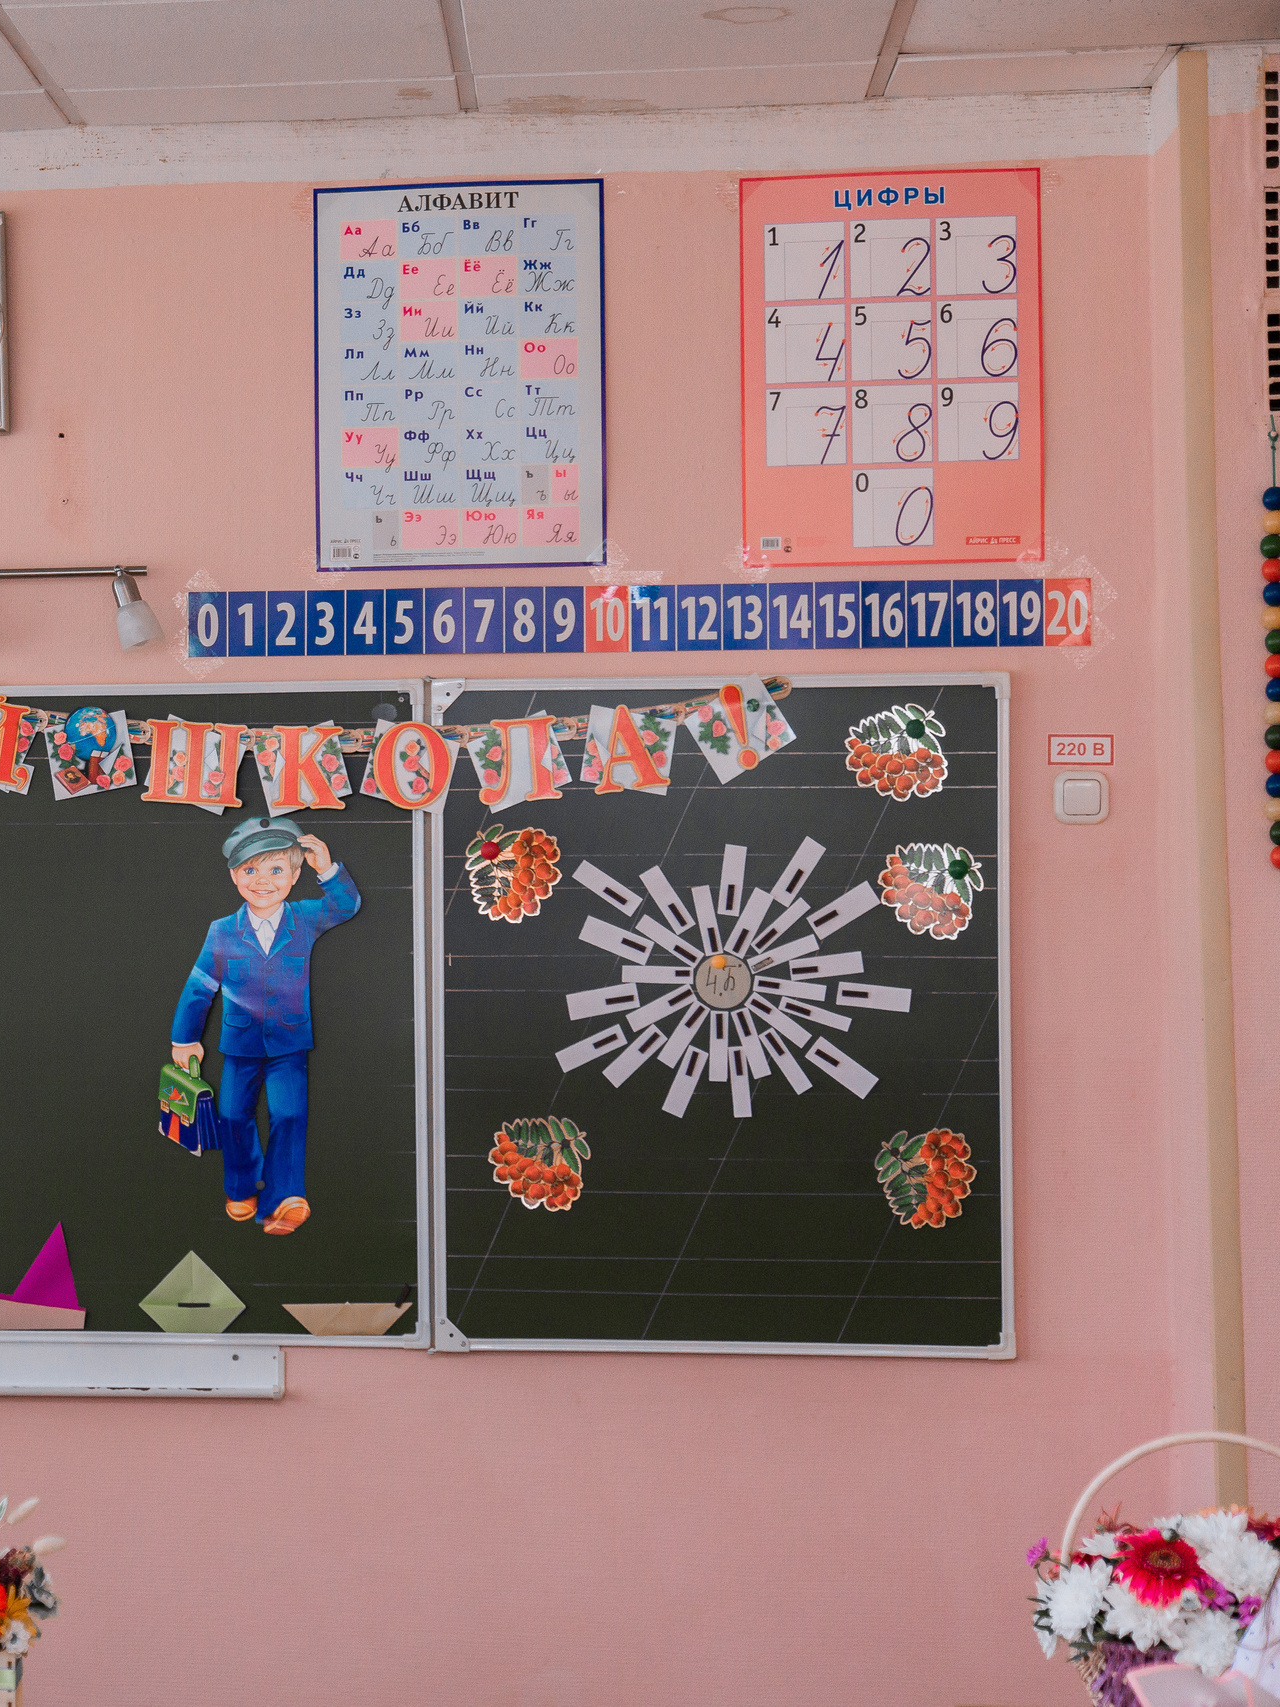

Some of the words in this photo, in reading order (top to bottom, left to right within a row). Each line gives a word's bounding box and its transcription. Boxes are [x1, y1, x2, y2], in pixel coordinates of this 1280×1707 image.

[398, 192, 518, 212] АЛФАВИТ
[835, 187, 944, 210] ЦИФРЫ
[344, 226, 361, 235] Аа
[403, 221, 420, 232] Бб
[464, 220, 479, 230] Вв
[524, 218, 536, 228] Гг
[768, 227, 778, 246] 1
[854, 224, 865, 243] 2
[940, 221, 951, 240] 3
[344, 267, 365, 279] Дд
[403, 265, 418, 274] Ее
[465, 261, 480, 272] Ёё
[524, 260, 551, 270] Жж
[345, 308, 361, 318] Зз
[403, 306, 421, 316] Ии
[465, 303, 483, 314] Йй
[525, 302, 542, 312] Кк
[768, 309, 781, 328] 4
[855, 306, 866, 325] 5
[941, 304, 952, 323] 6
[345, 349, 363, 359] Лл
[405, 348, 429, 357] Мм
[465, 345, 483, 355] Нн
[524, 342, 545, 353] Оо
[345, 391, 363, 401] Пп
[405, 389, 423, 401] Рр
[465, 387, 482, 397] Сс
[526, 385, 540, 395] Тт
[770, 392, 781, 411] 7
[855, 389, 868, 409] 8
[942, 387, 953, 407] 9
[345, 432, 362, 444] Уу
[404, 430, 429, 442] Фф
[466, 429, 482, 439] Хх
[527, 427, 547, 439] Цц
[346, 472, 362, 482] Чч
[404, 471, 431, 481] Шш
[467, 469, 495, 481] Щщ
[856, 473, 869, 492] 0
[405, 512, 421, 522] Ээ
[466, 511, 496, 521] Юю
[527, 509, 544, 519] Яя
[197, 603, 218, 647] 0
[238, 604, 254, 646] 1
[275, 603, 296, 646] 2
[315, 602, 335, 646] 3
[353, 602, 376, 645] 4
[394, 601, 414, 644] 5
[432, 599, 456, 643] 6
[474, 599, 494, 643] 7
[512, 599, 536, 643] 8
[555, 597, 576, 642] 9
[590, 598, 625, 642] 10
[636, 597, 669, 641] 11
[681, 596, 718, 640] 12
[727, 595, 763, 640] 13
[772, 594, 811, 639] 14
[819, 594, 856, 639] 15
[865, 593, 904, 637] 16
[911, 592, 948, 637] 17
[957, 592, 996, 636] 18
[1003, 591, 1041, 636] 19
[1047, 590, 1087, 635] 20
[141, 683, 760, 811] ШКОЛА!
[1057, 743, 1086, 755] 220
[1093, 743, 1104, 755] В
